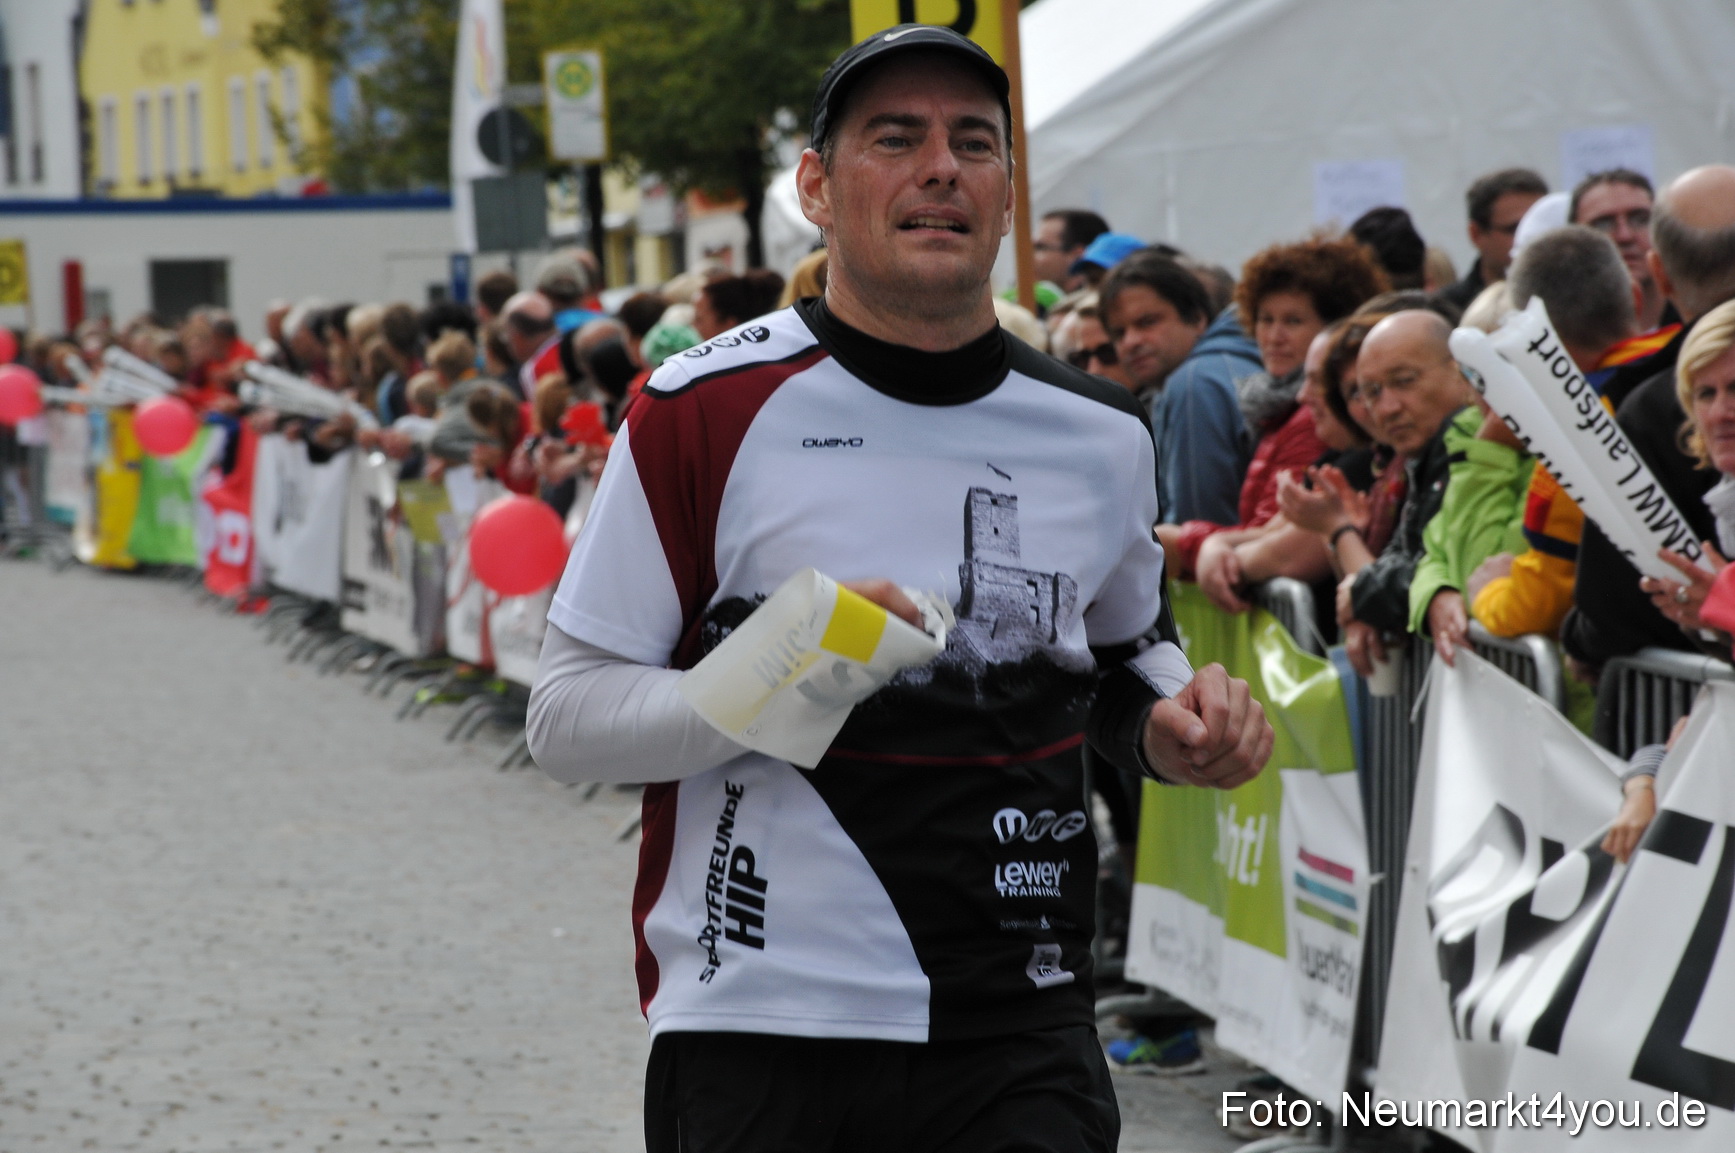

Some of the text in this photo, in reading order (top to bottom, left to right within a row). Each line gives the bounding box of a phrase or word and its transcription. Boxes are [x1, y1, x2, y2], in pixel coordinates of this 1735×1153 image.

[1526, 328, 1643, 486] Laufsport
[698, 779, 744, 985] SPORTFREUNDE
[724, 845, 769, 951] HIP
[1000, 885, 1062, 898] TRAINING
